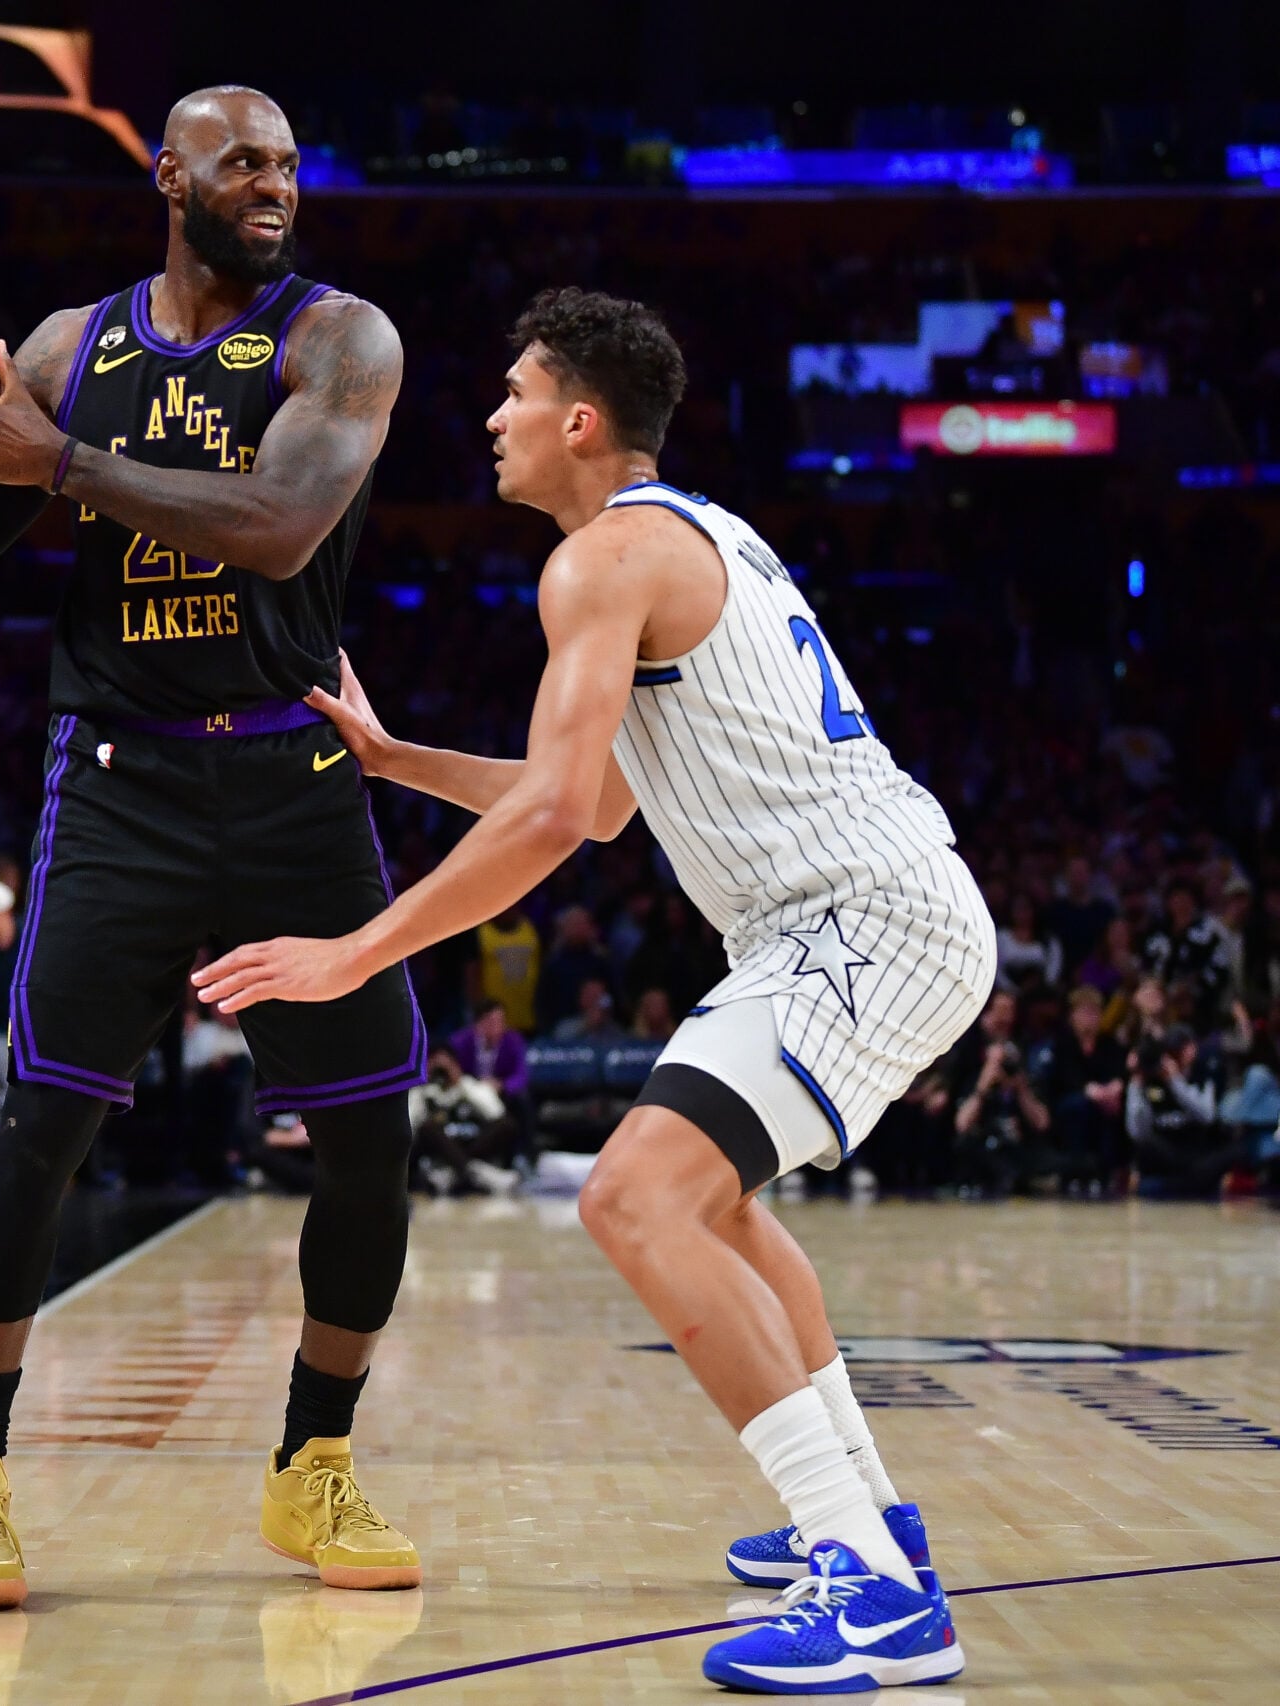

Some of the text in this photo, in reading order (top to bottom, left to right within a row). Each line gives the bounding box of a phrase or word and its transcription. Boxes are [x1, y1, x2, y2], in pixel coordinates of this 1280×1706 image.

[223, 341, 270, 358] bibigo
[144, 375, 256, 475] ANGELE
[121, 593, 239, 642] LAKERS
[787, 614, 878, 744] 2
[205, 713, 233, 732] LAL
